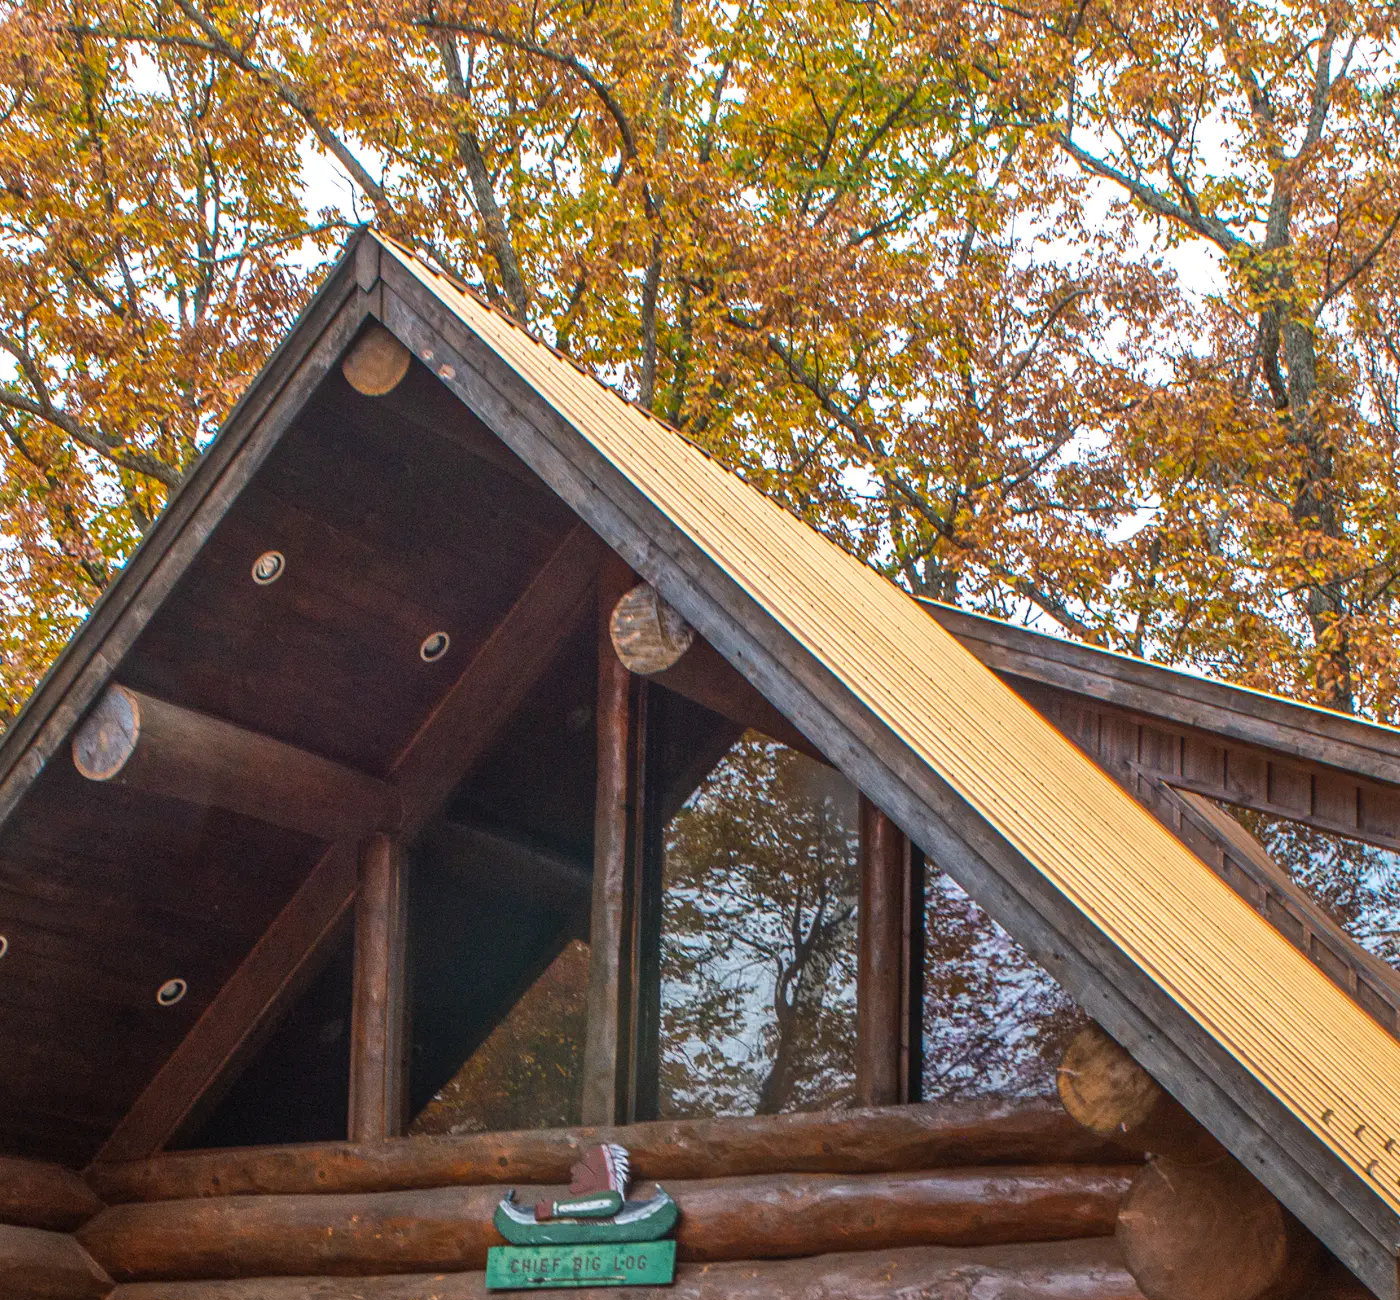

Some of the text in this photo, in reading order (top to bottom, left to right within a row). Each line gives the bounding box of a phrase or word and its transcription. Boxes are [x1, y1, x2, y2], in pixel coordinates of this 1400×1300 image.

[510, 1255, 648, 1273] CHIEF BIG LOG
